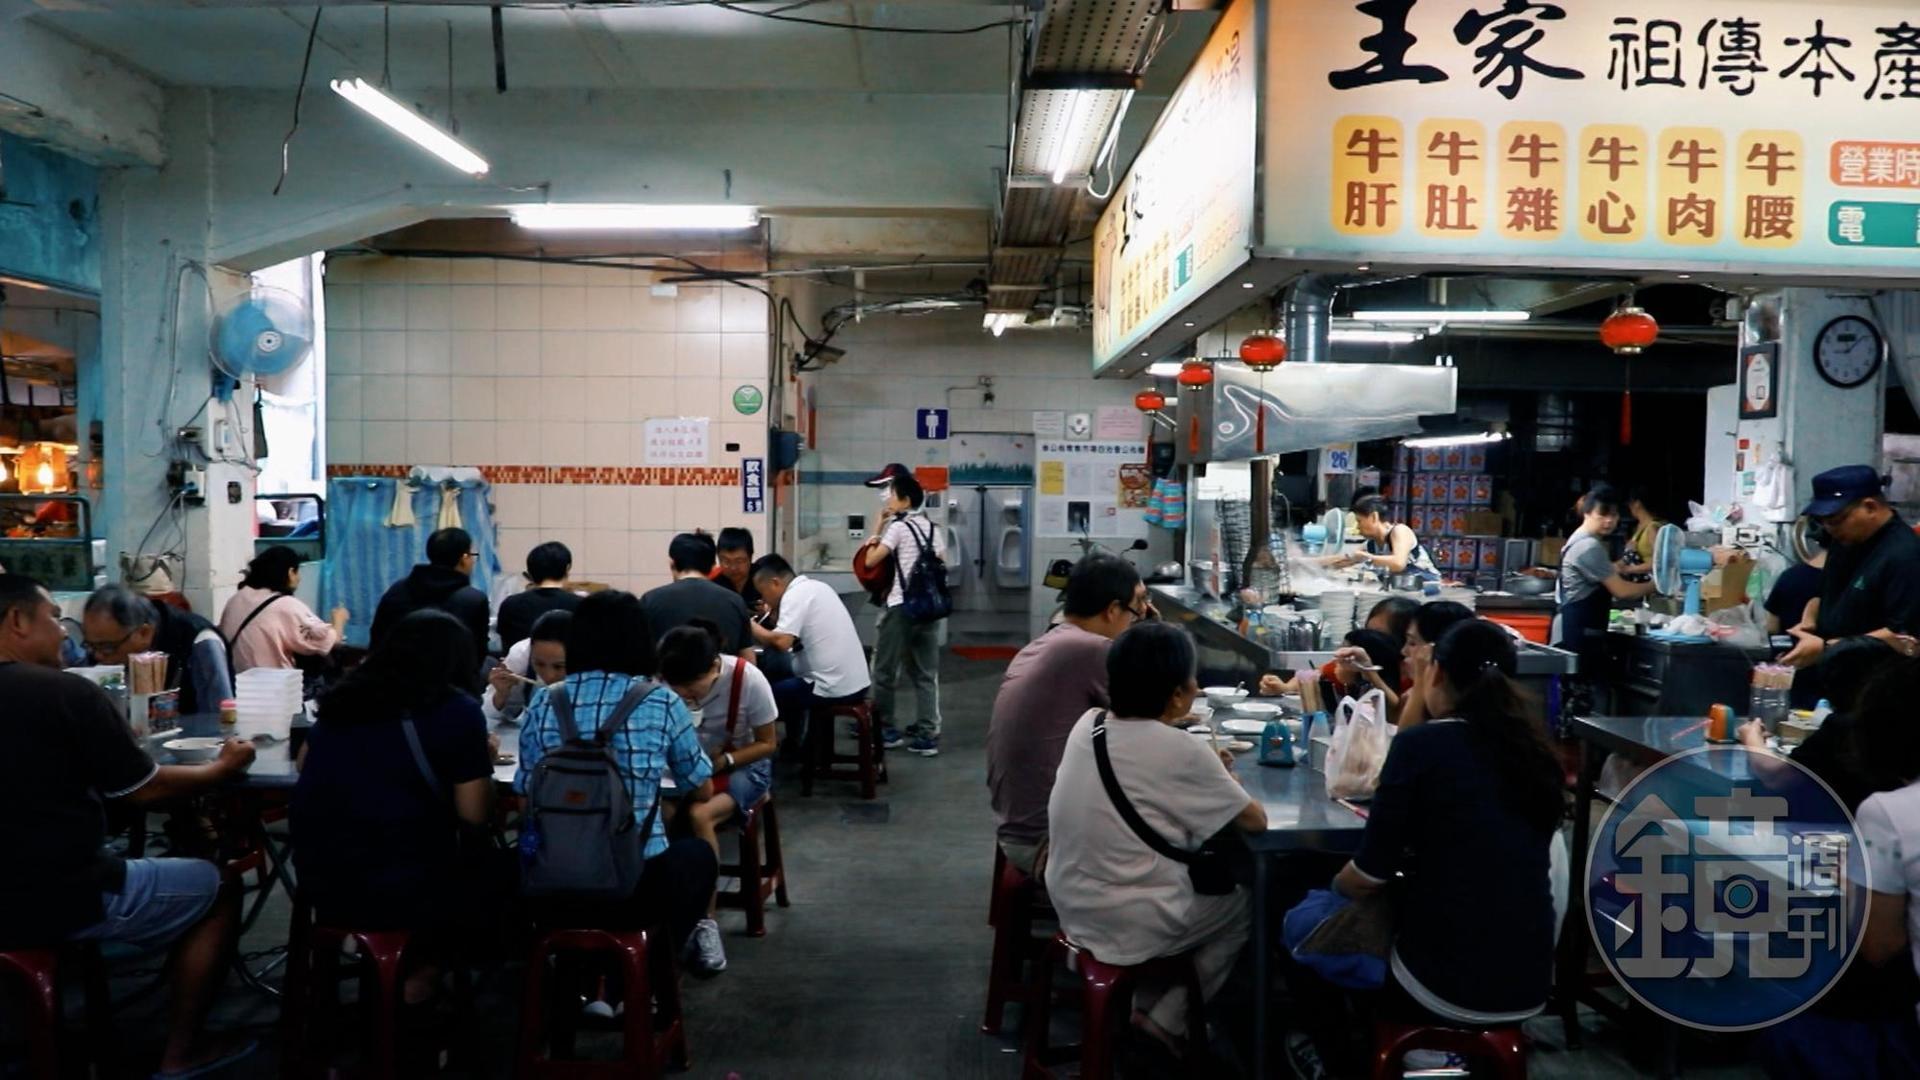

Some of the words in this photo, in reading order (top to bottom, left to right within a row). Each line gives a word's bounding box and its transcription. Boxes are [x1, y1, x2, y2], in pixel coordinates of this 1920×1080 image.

[1328, 0, 1586, 100] 王家
[1606, 16, 1920, 100] 祖傳本產
[1345, 128, 1399, 228] 牛肝
[1425, 131, 1479, 230] 牛肚
[1506, 133, 1559, 232] 牛雜
[1586, 136, 1639, 234] 牛心
[1666, 139, 1718, 238] 牛肉
[1743, 142, 1796, 240] 牛腰
[1839, 145, 1920, 185] 營業時
[1331, 451, 1348, 469] 26
